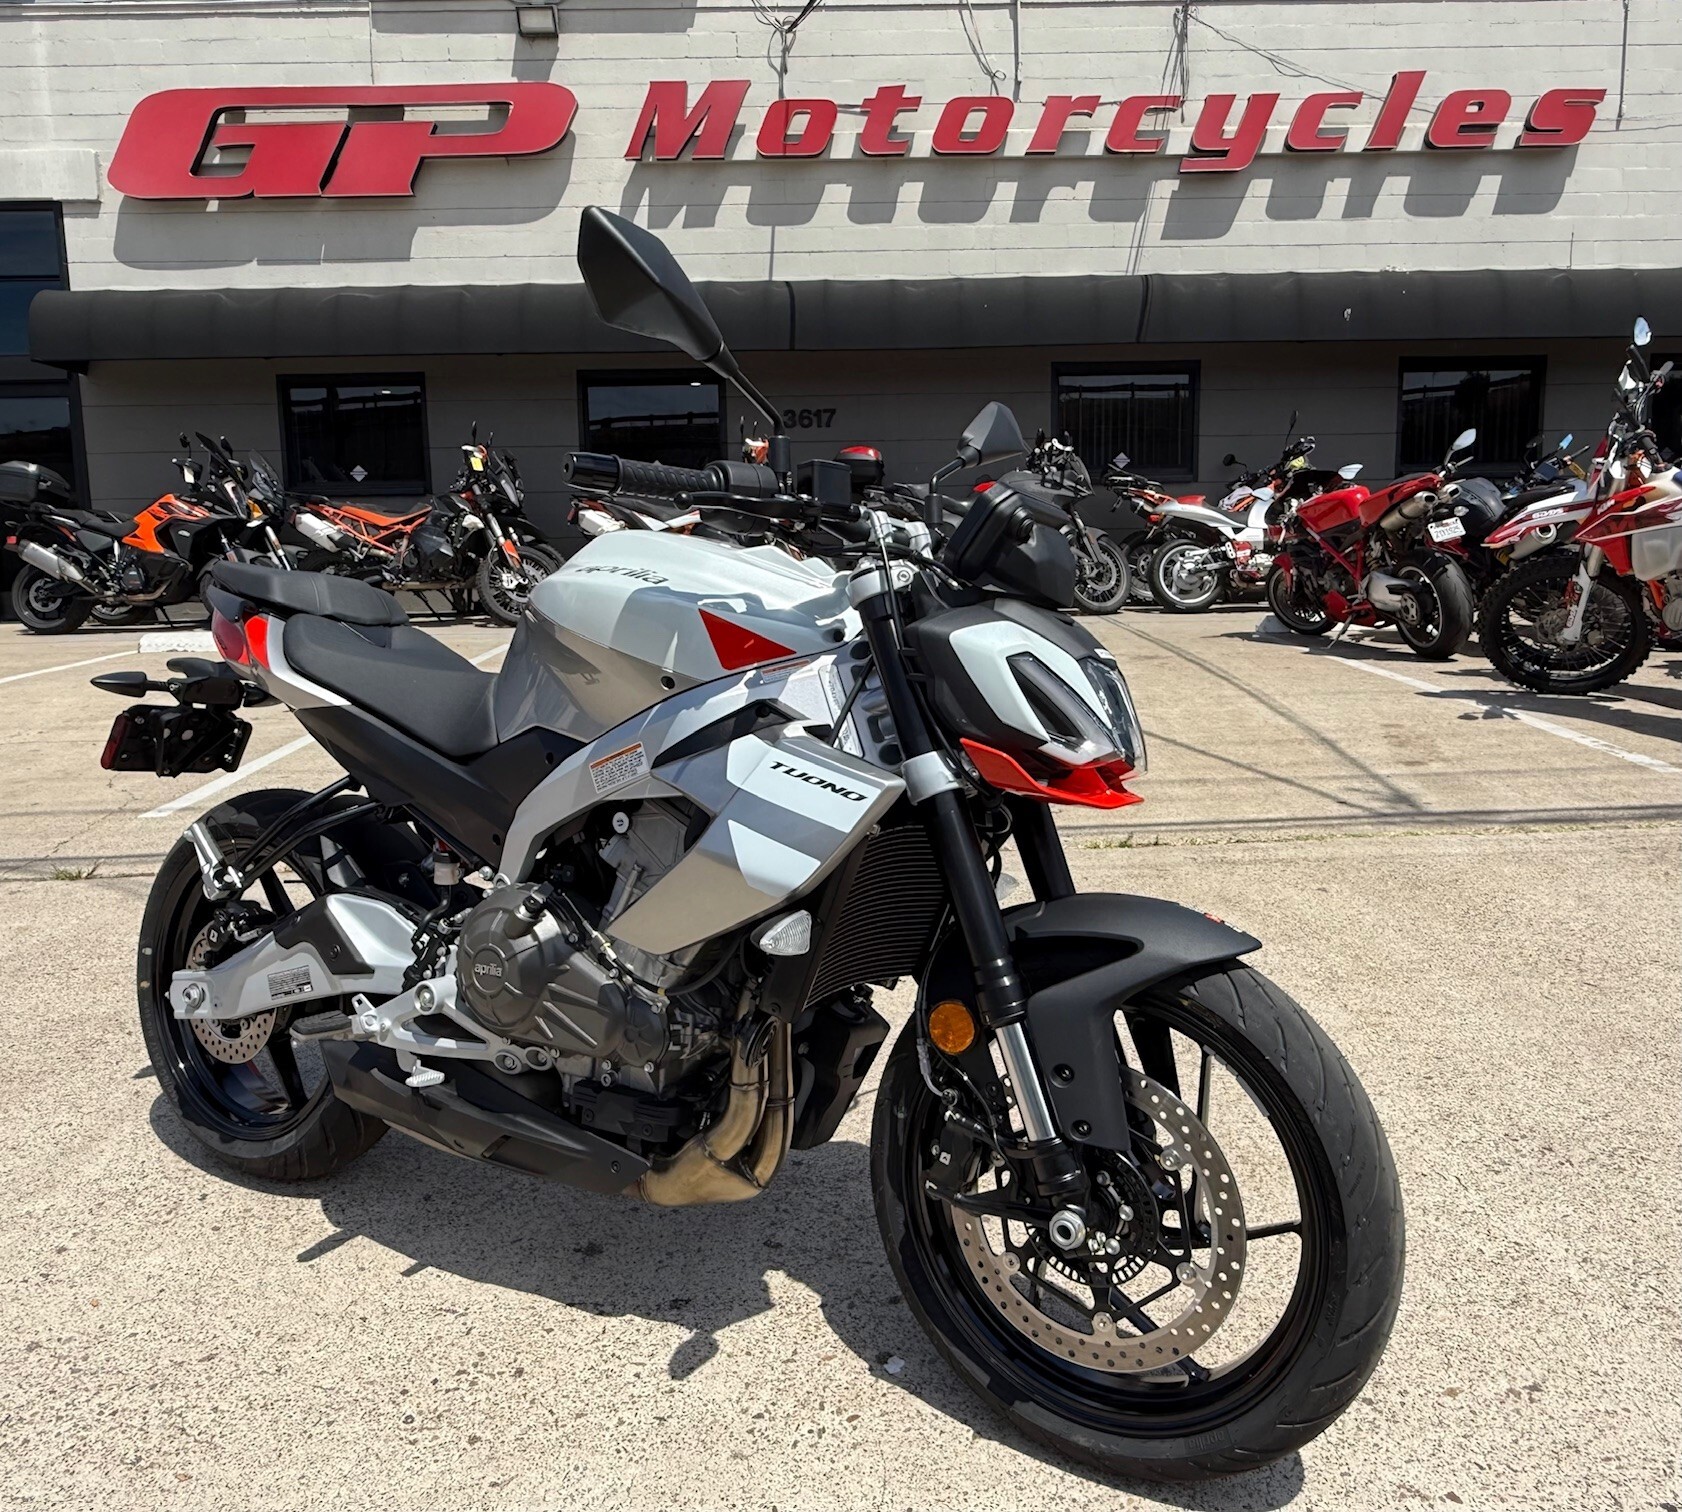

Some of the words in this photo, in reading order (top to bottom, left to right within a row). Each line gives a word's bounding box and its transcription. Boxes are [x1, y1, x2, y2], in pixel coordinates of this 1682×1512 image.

[107, 81, 578, 200] GP
[624, 70, 1607, 173] Motorcycles
[783, 408, 836, 429] 3617
[770, 761, 868, 801] TUONO
[474, 963, 503, 977] aprilia
